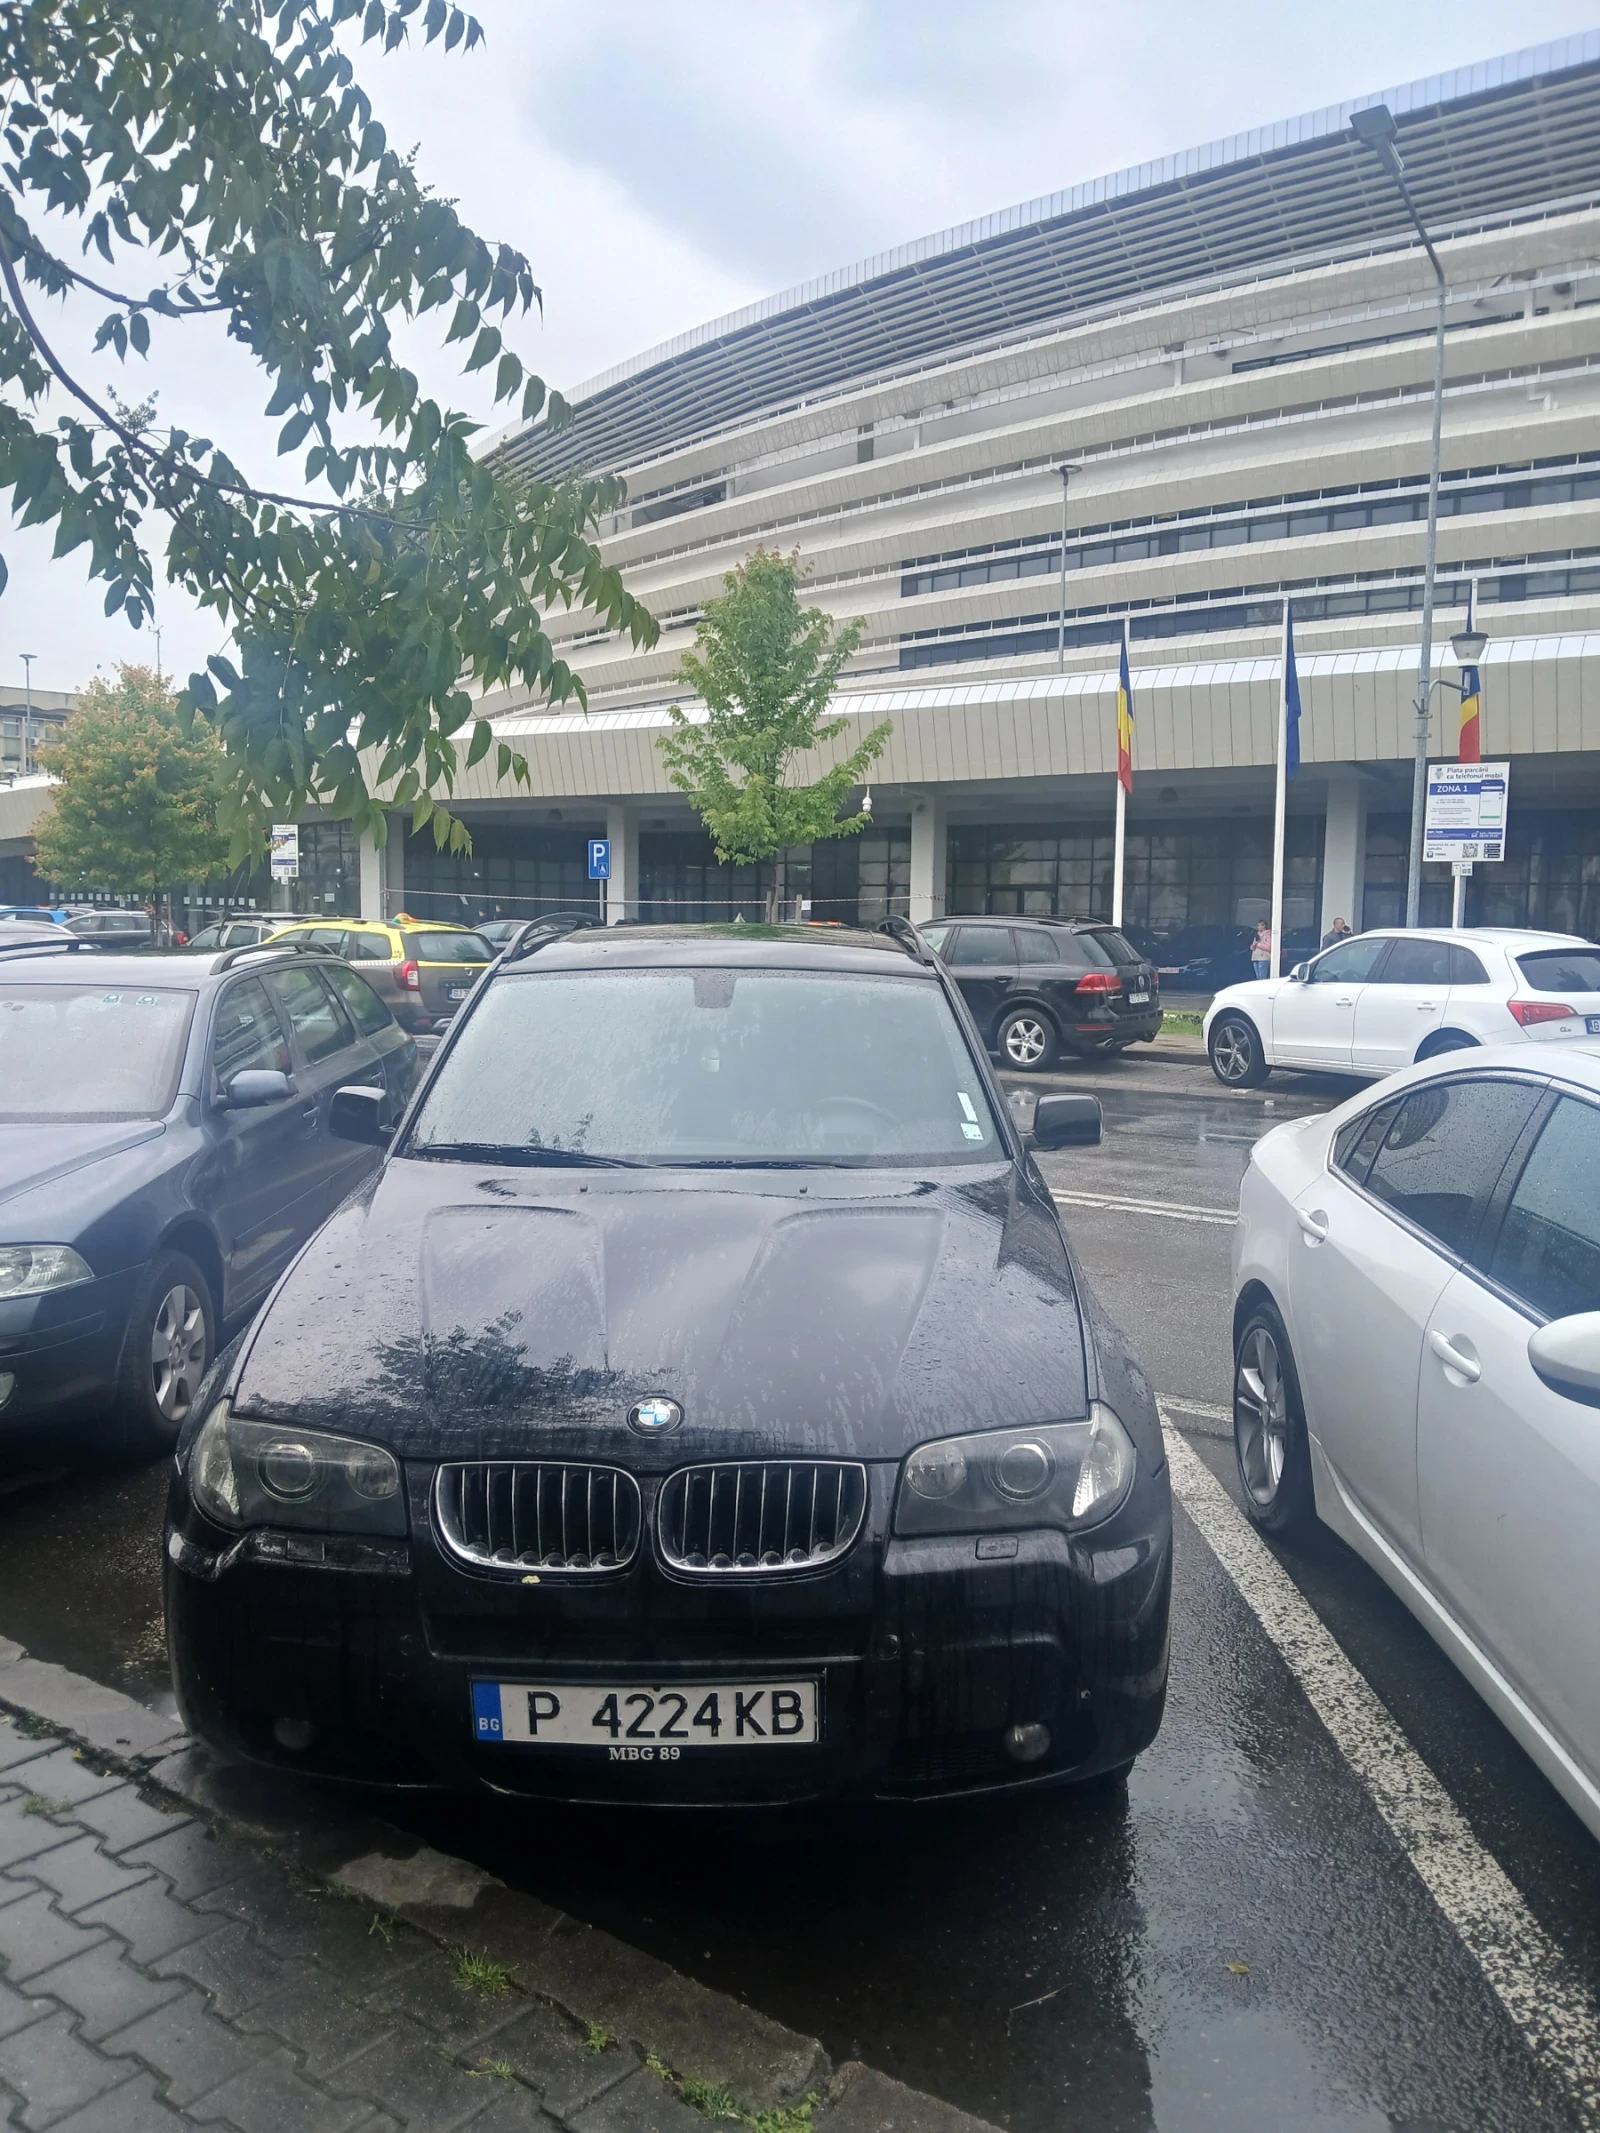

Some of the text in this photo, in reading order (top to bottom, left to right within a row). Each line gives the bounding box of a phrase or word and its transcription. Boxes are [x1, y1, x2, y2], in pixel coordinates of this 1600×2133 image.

[1437, 785, 1461, 793] ZONA
[593, 843, 606, 868] P
[635, 1399, 677, 1410] BMW
[527, 1690, 561, 1736] P
[478, 1717, 500, 1731] BG
[608, 1747, 681, 1761] MBG 89
